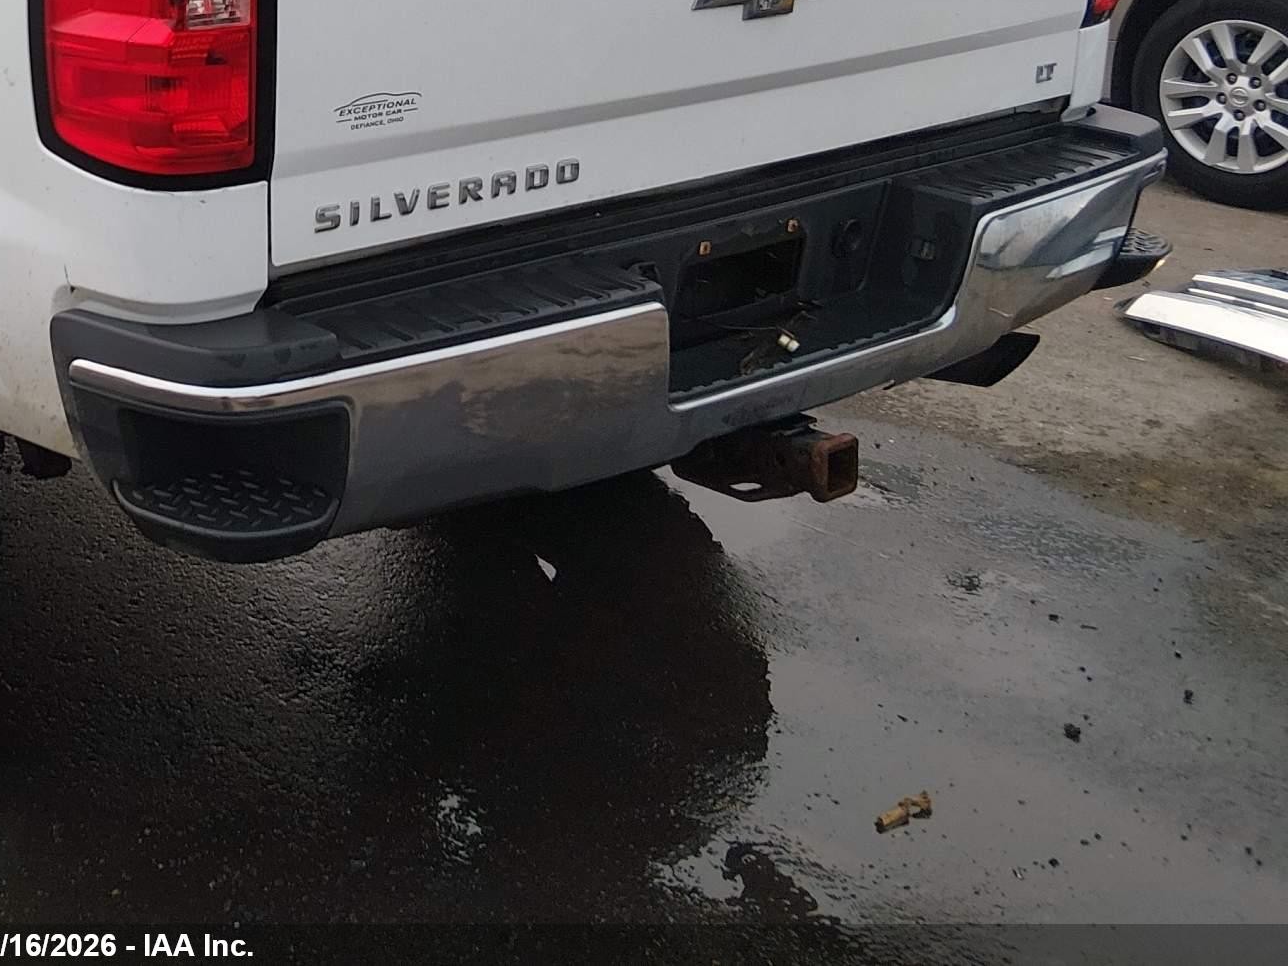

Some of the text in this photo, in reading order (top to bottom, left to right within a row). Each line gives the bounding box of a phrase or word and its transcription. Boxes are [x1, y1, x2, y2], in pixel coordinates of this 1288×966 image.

[1036, 62, 1057, 83] LT
[338, 98, 416, 117] EXCEPTIONAL
[353, 108, 402, 121] MOTOR CAR
[350, 116, 404, 130] DEFIANCE, OHIO
[313, 157, 581, 234] SILVERADO
